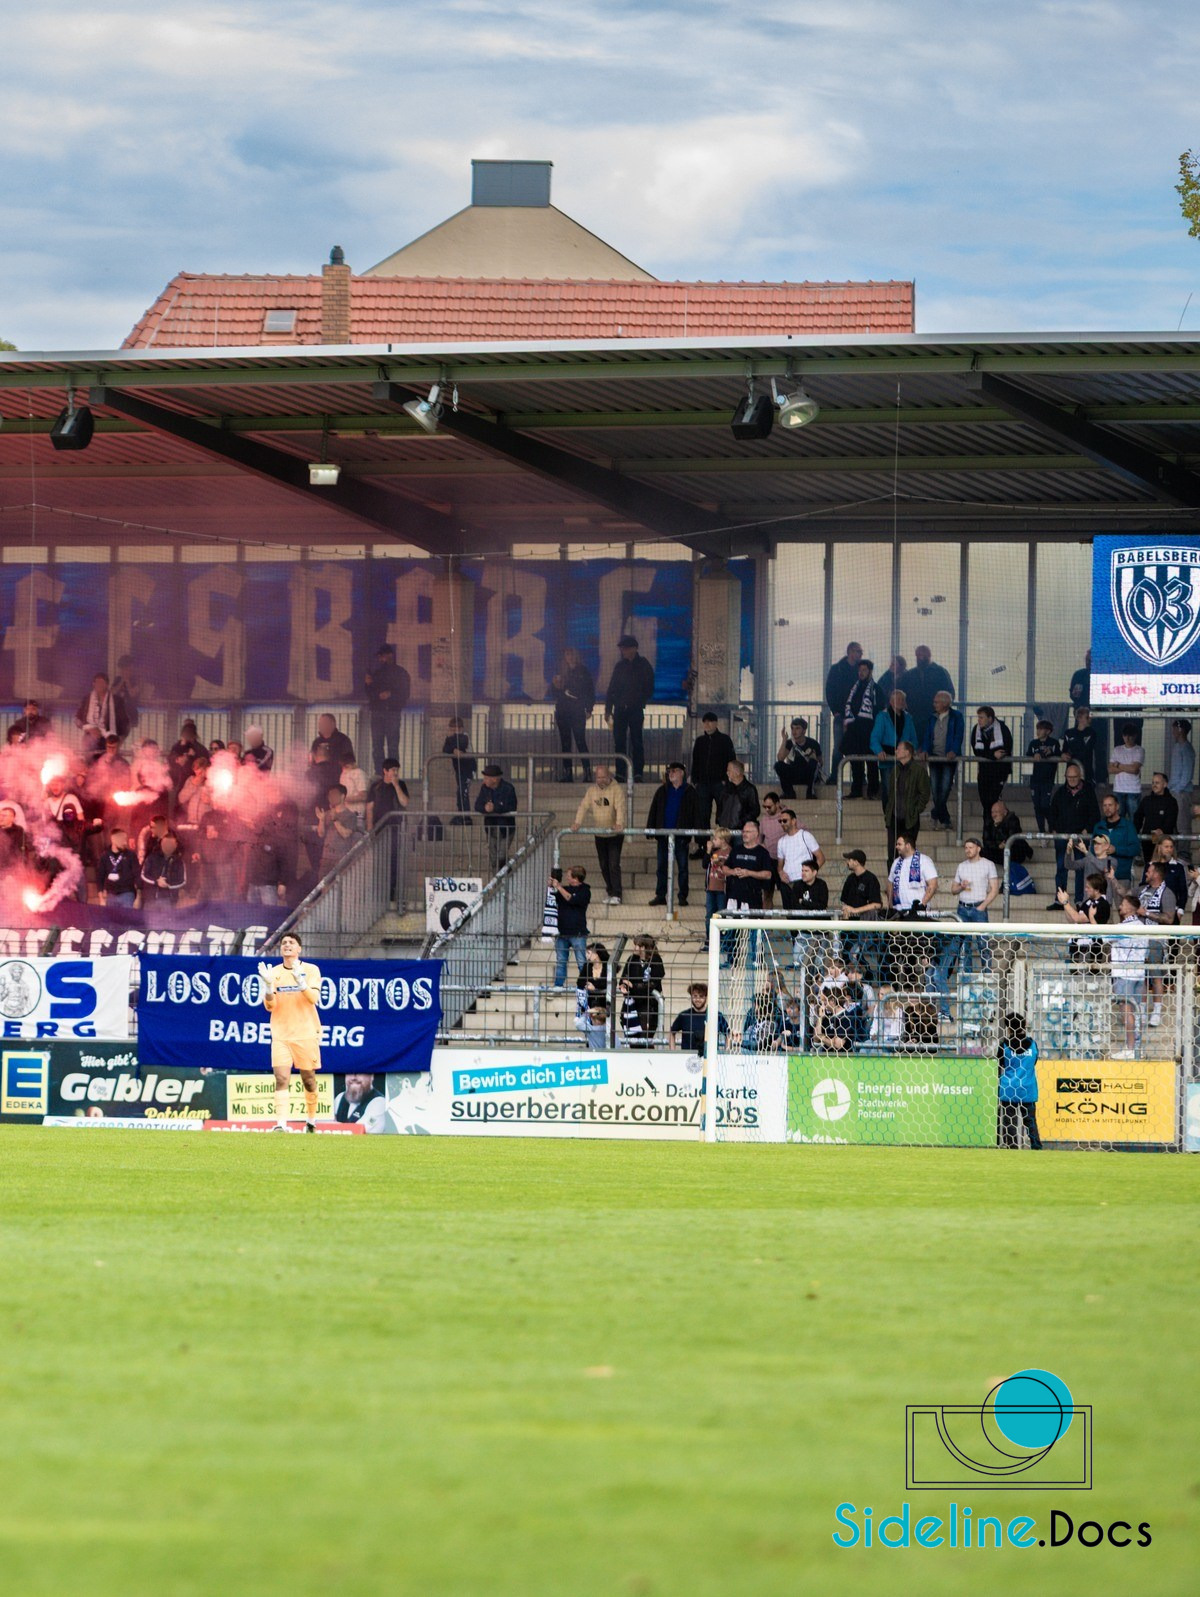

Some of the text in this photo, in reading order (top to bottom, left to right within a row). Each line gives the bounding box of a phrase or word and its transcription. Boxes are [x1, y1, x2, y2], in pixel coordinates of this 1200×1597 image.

[1117, 550, 1200, 564] BABELSBER
[1126, 576, 1194, 632] 03
[1101, 682, 1148, 696] Katjes
[146, 970, 434, 1011] LOS COORTOS
[209, 1019, 366, 1048] BABEERG
[459, 1064, 602, 1091] Bewirb dich jetzt!
[60, 1072, 205, 1103] Gabler
[235, 1082, 251, 1093] Wir
[255, 1081, 275, 1093] sind
[296, 1081, 305, 1093] Si
[615, 1083, 645, 1097] Job
[651, 1088, 660, 1097] +
[857, 1082, 974, 1097] Energie und Wasser
[5, 1101, 43, 1109] EDEKA
[232, 1103, 248, 1115] Mo.
[251, 1103, 264, 1114] bis
[451, 1097, 758, 1123] superberater.com/obs
[858, 1098, 908, 1108] Stadtwerke
[1056, 1098, 1147, 1115] KÖNIG
[144, 1106, 212, 1120] Potsdam
[858, 1109, 895, 1118] Potsdam
